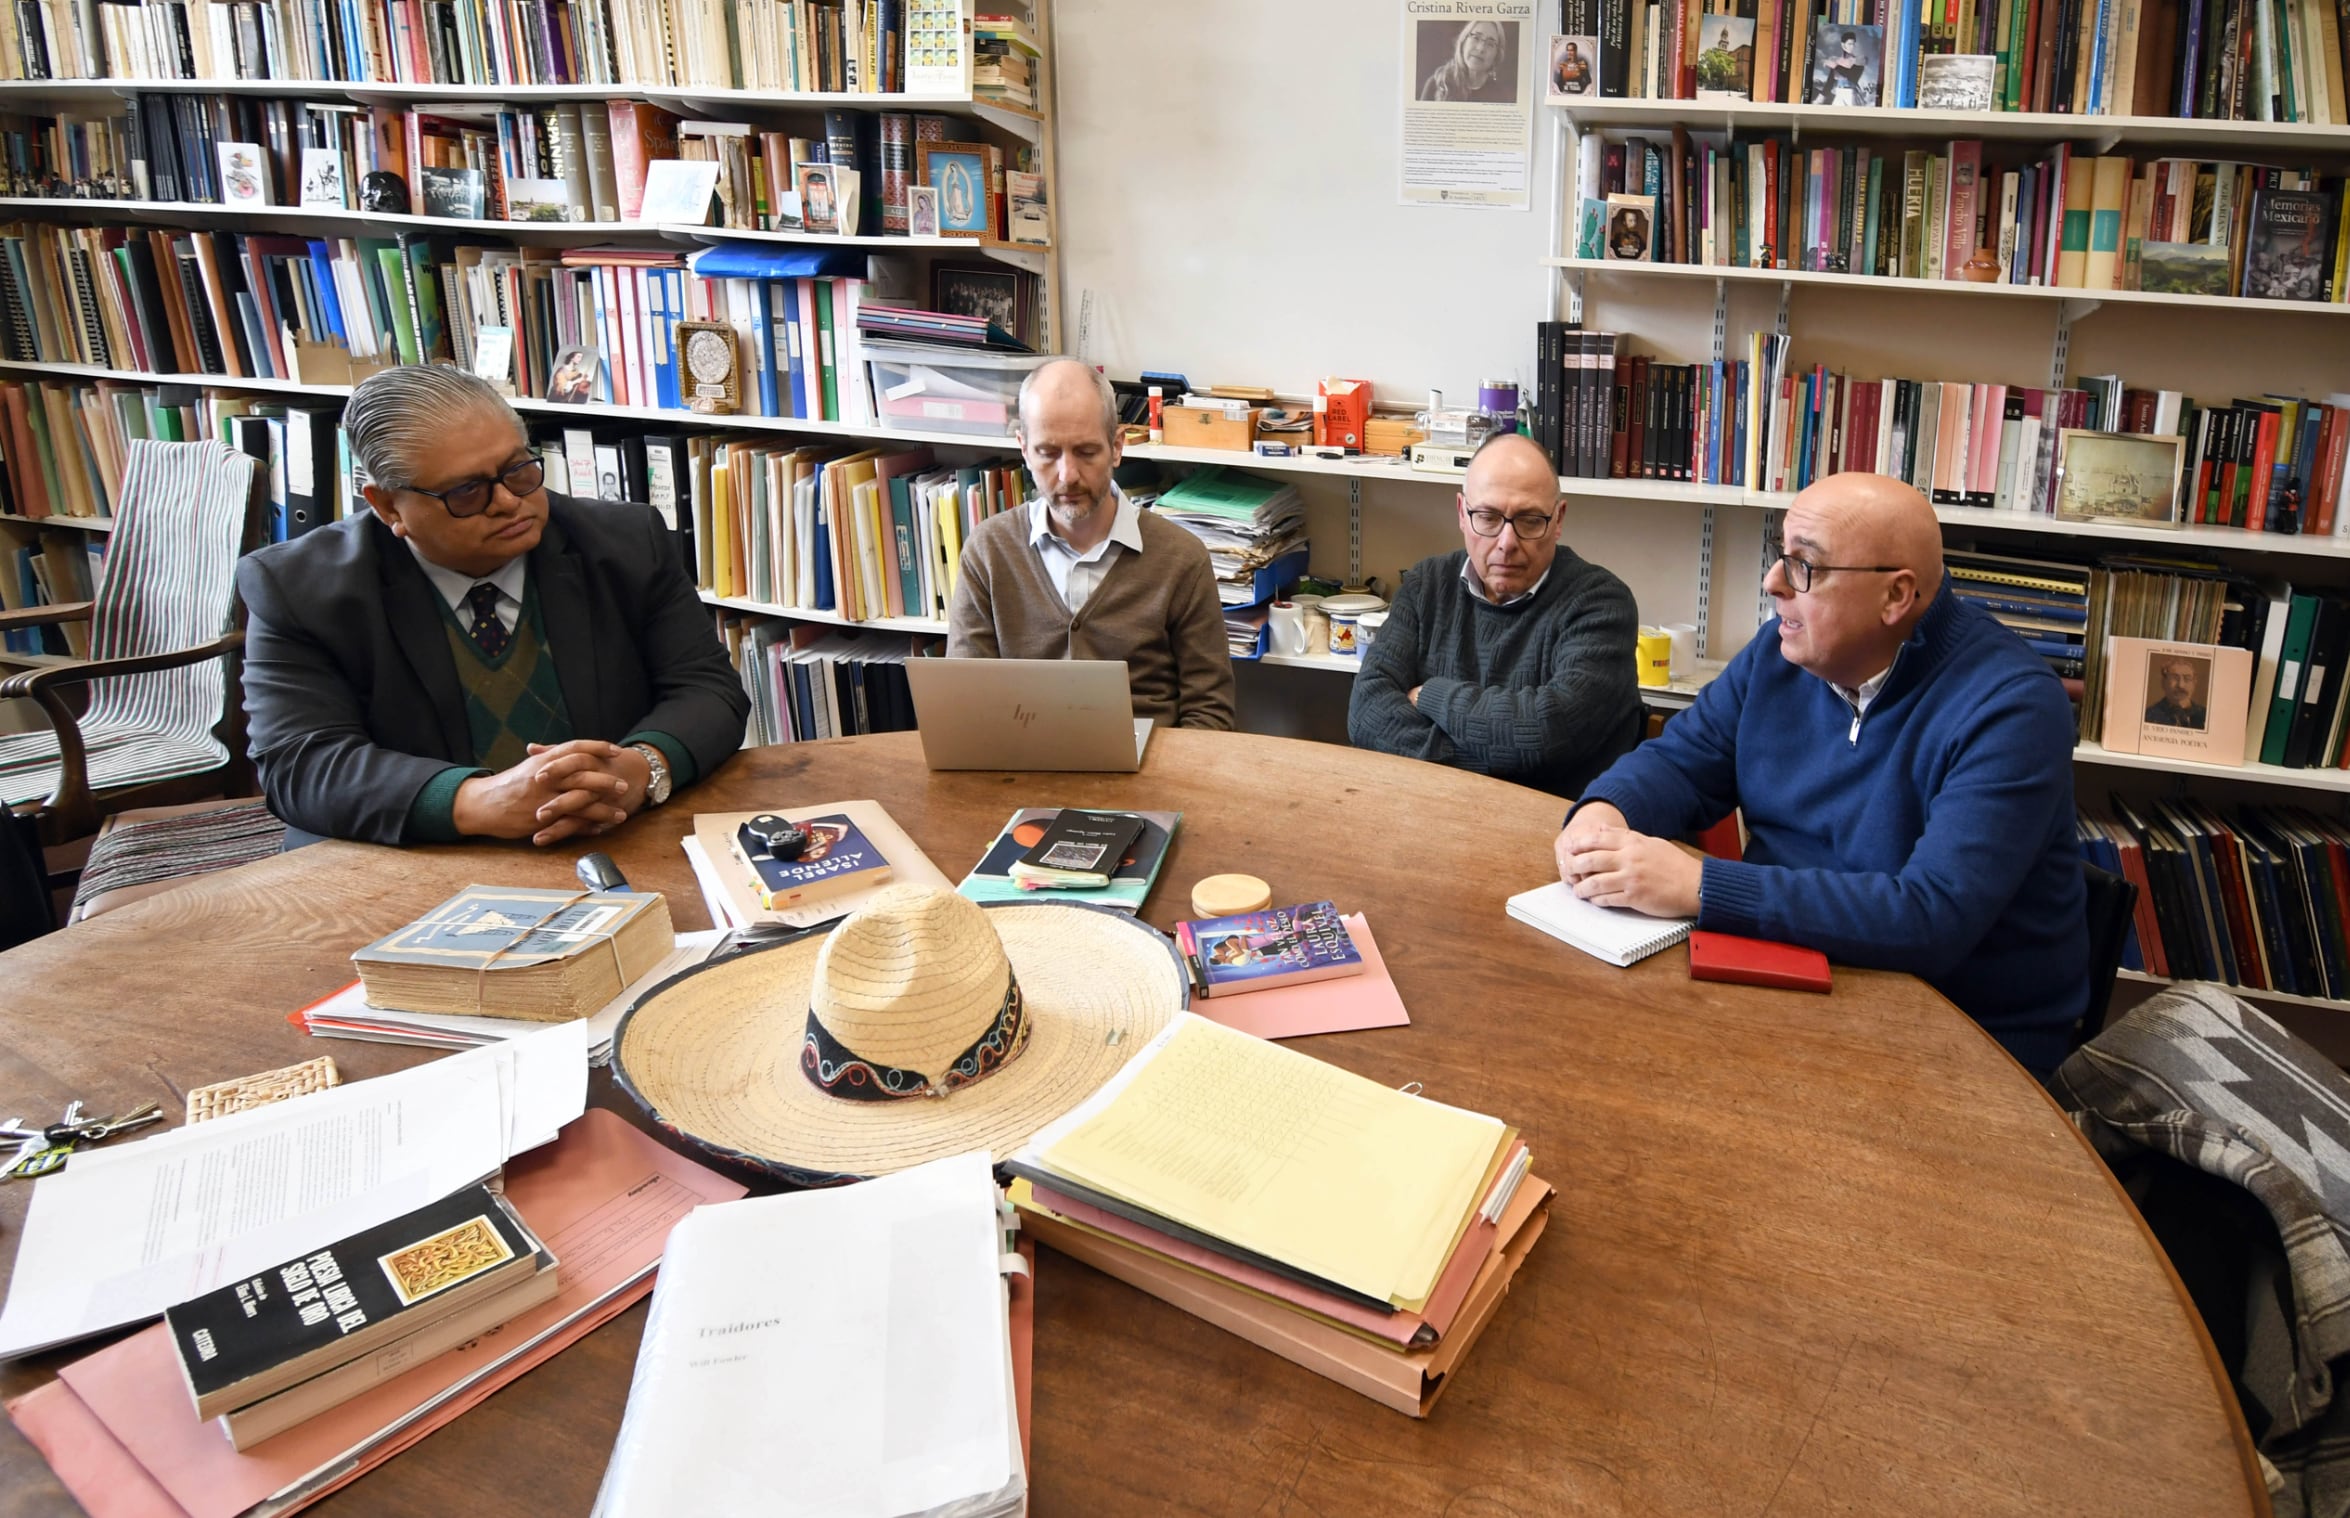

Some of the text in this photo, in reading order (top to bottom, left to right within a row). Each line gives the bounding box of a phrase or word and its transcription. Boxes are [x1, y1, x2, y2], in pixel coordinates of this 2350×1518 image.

[1407, 1, 1531, 14] Cristina Rivera Garza
[1906, 168, 1924, 218] HUERTA
[2263, 198, 2321, 213] Memorias
[2217, 182, 2230, 233] AGRARIAN
[2262, 210, 2320, 225] Mexicano
[1952, 192, 1970, 250] Pancho Villa
[416, 336, 424, 366] HISTO
[1332, 408, 1346, 416] RED
[1013, 704, 1036, 728] hp
[779, 852, 863, 878] ALLENDE
[793, 860, 860, 880] ISABEL
[1267, 919, 1294, 965] TAN VELOZ
[1287, 936, 1298, 946] EL
[1302, 919, 1329, 956] LAURA
[1312, 909, 1346, 961] ESQUIVEL
[1291, 945, 1310, 968] COMO
[279, 1262, 331, 1326] SIGLO DE ORO
[306, 1250, 368, 1334] POESIA LIRICA DEL
[242, 1300, 258, 1318] Rivers
[698, 1318, 781, 1339] Traidores
